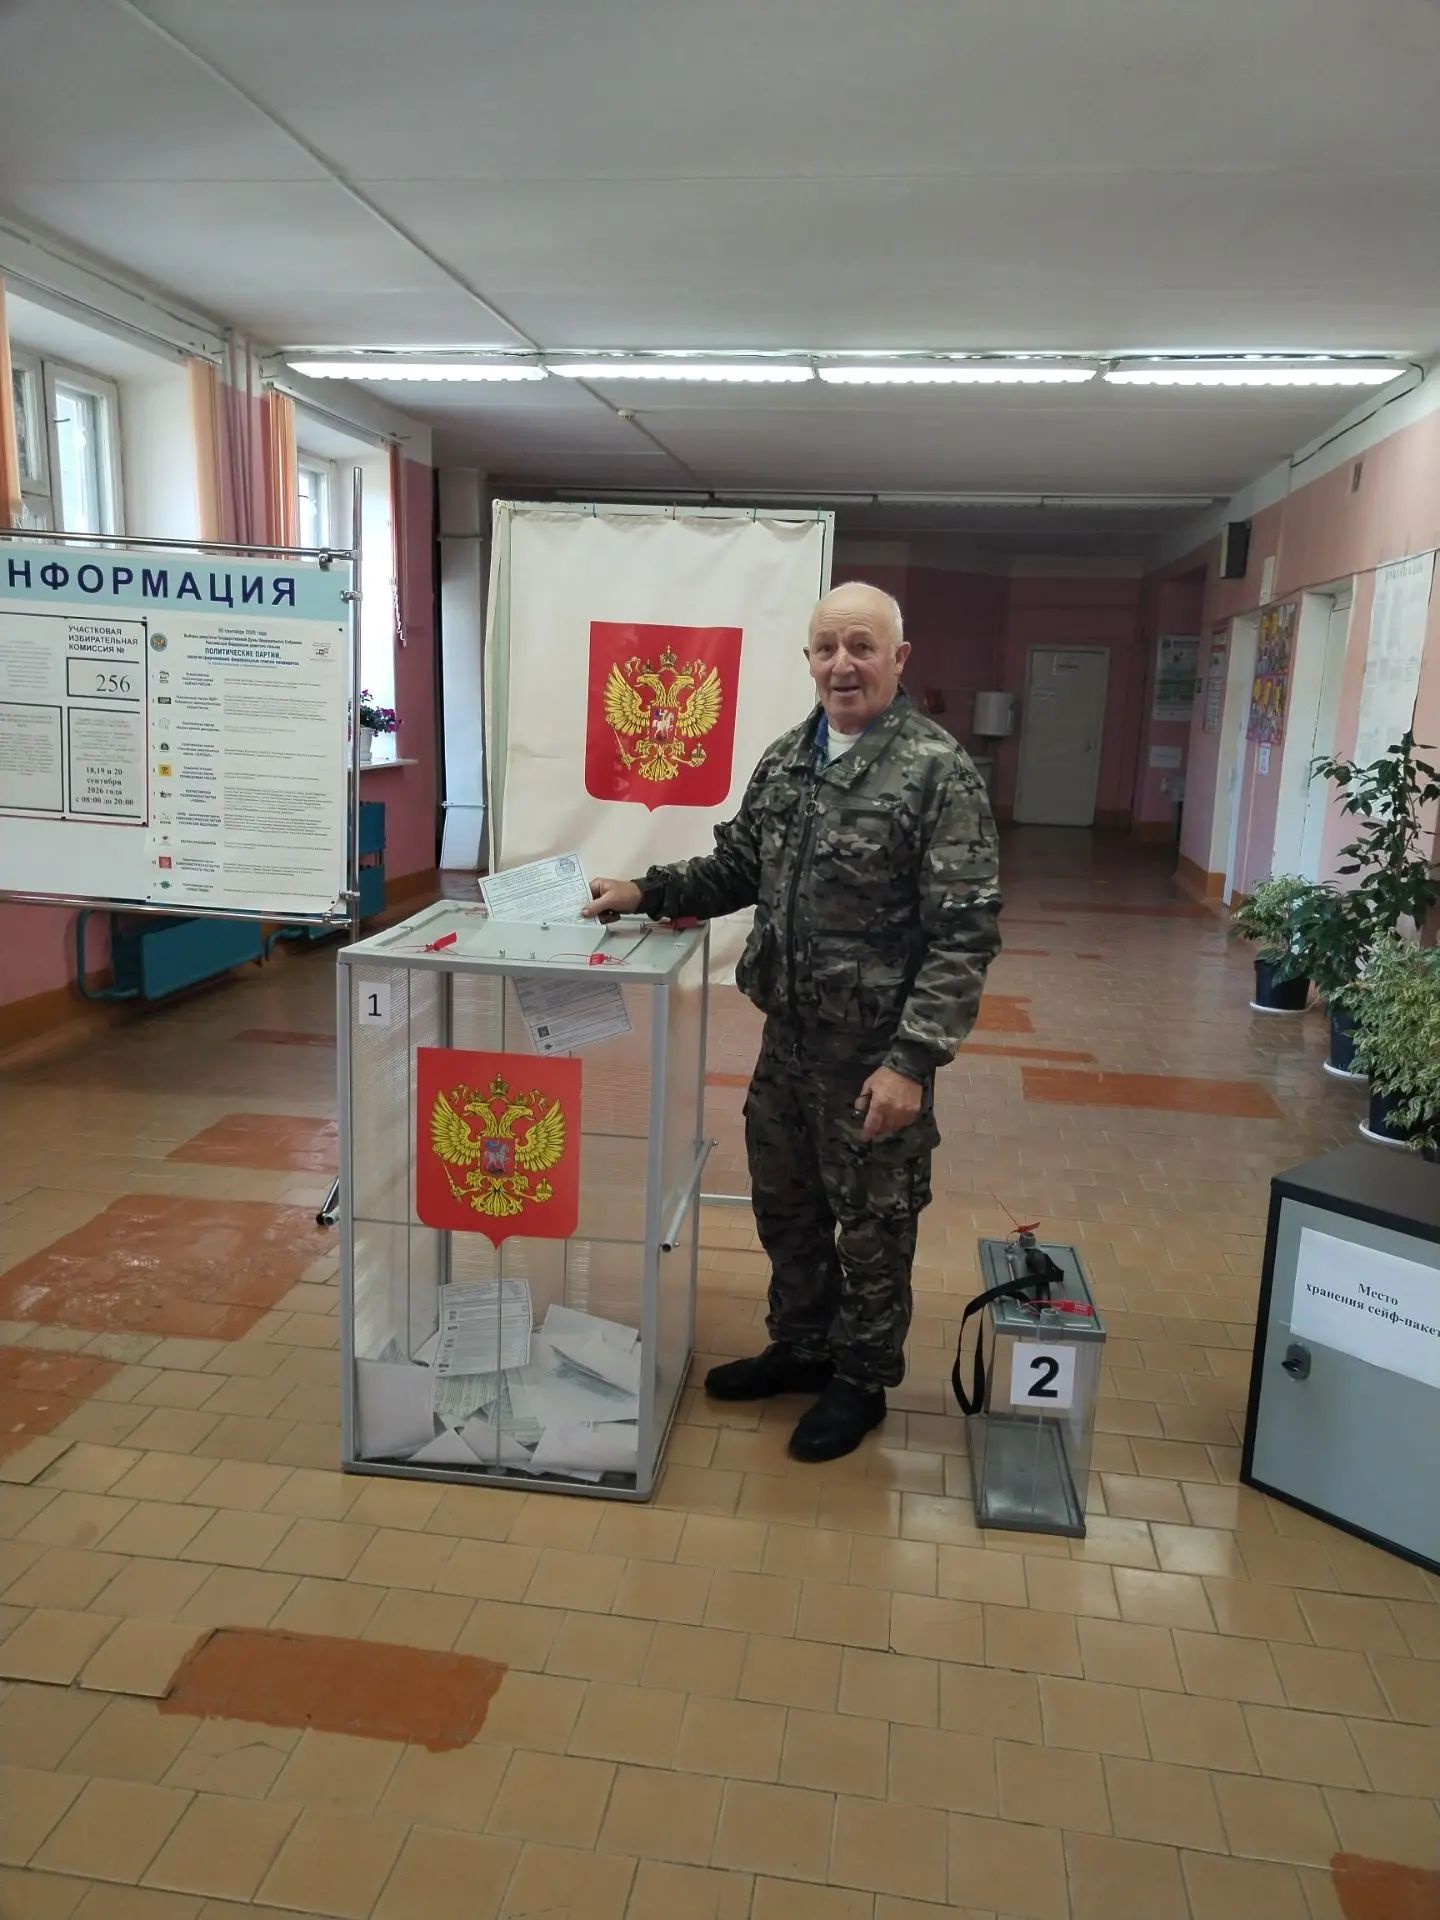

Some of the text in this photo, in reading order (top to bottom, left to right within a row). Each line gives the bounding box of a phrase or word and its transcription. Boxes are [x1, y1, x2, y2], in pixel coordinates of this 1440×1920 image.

[8, 558, 296, 608] НФОРМАЦИЯ
[68, 625, 122, 635] УЧАСТКОВАЯ
[69, 635, 138, 645] ИЗБИРАТЕЛЬНАЯ
[69, 644, 114, 653] КОМИССИЯ
[205, 648, 282, 660] ПОЛИТИЧЕСКИЕ ПАРТИИ,
[96, 674, 130, 692] 256
[367, 993, 382, 1017] 1
[1305, 1283, 1364, 1310] хранения
[1358, 1283, 1398, 1306] Место
[1028, 1356, 1059, 1398] 2
